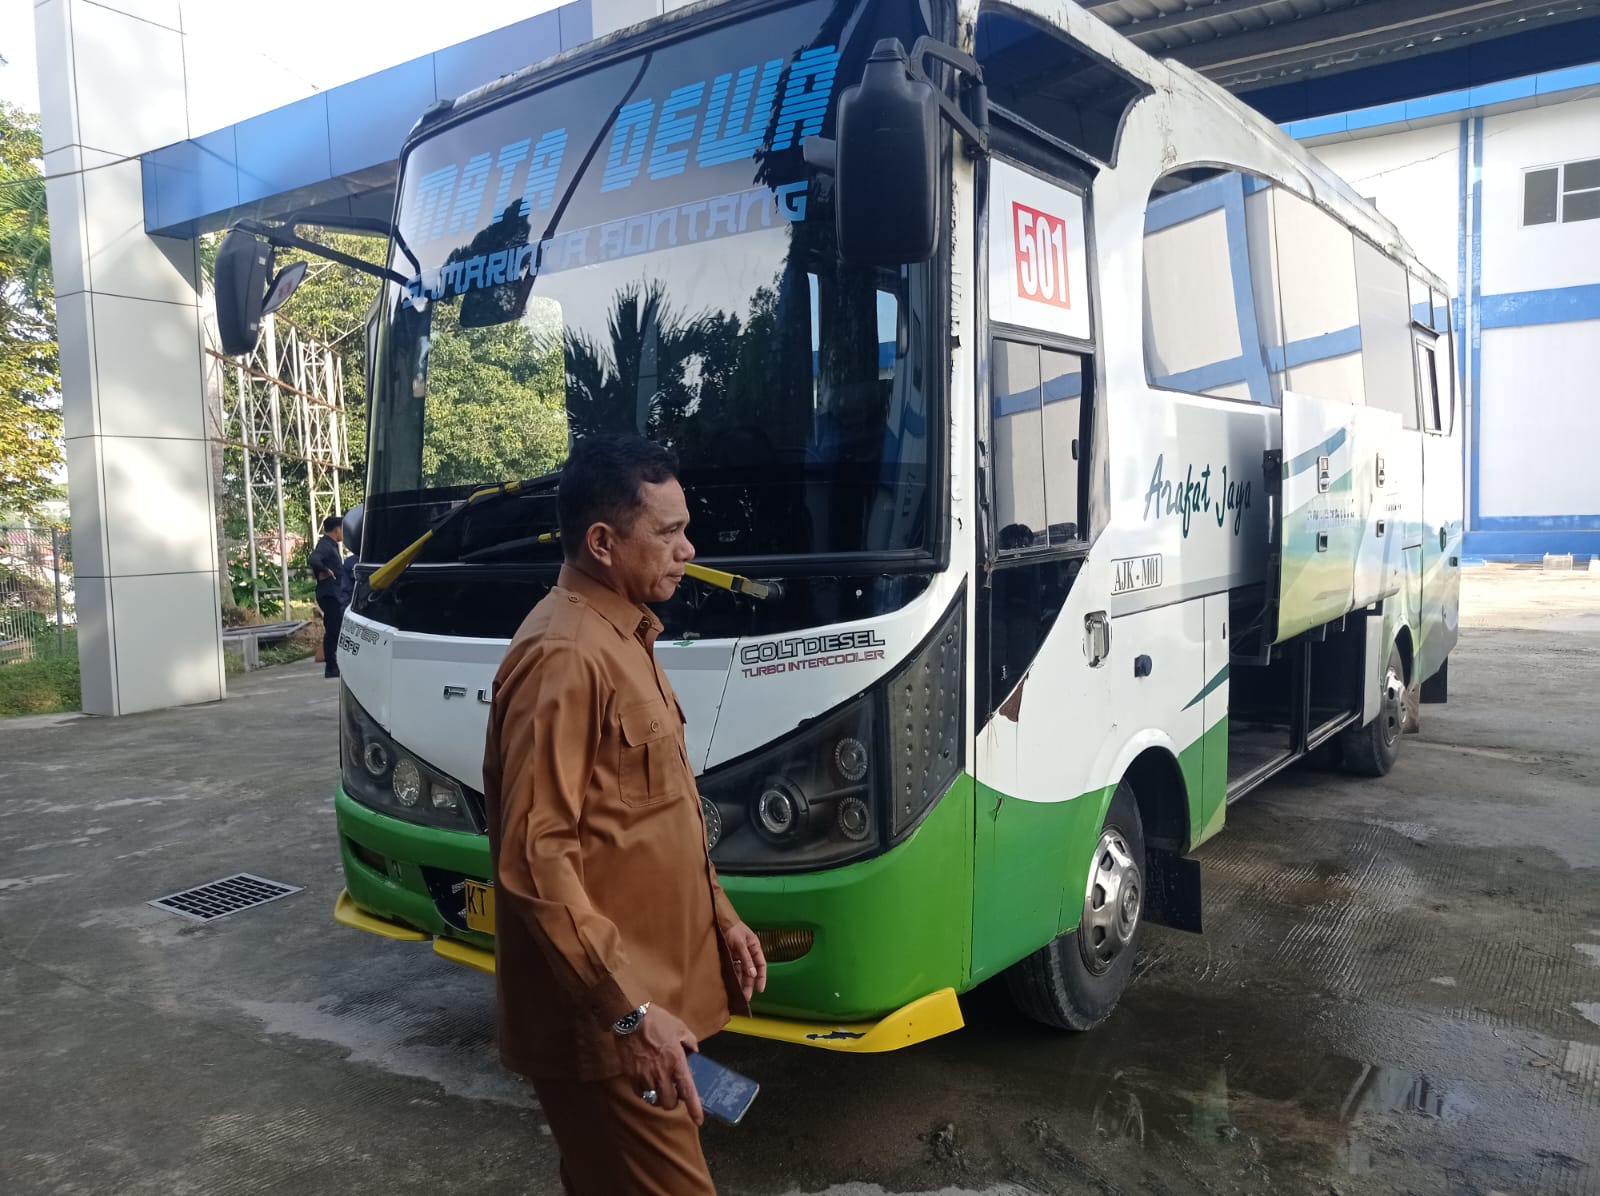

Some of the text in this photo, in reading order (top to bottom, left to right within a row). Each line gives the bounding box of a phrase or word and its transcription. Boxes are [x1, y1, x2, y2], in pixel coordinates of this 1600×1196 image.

[407, 44, 841, 246] MATA DEWA
[402, 180, 808, 309] SAMARINA BONTANG
[1018, 209, 1067, 302] 501
[1143, 453, 1252, 539] Arafat Jaya
[1114, 560, 1134, 592] AJK
[1142, 557, 1159, 587] M01
[742, 650, 885, 679] TURBO INTERCOOLER
[467, 884, 487, 916] KT
